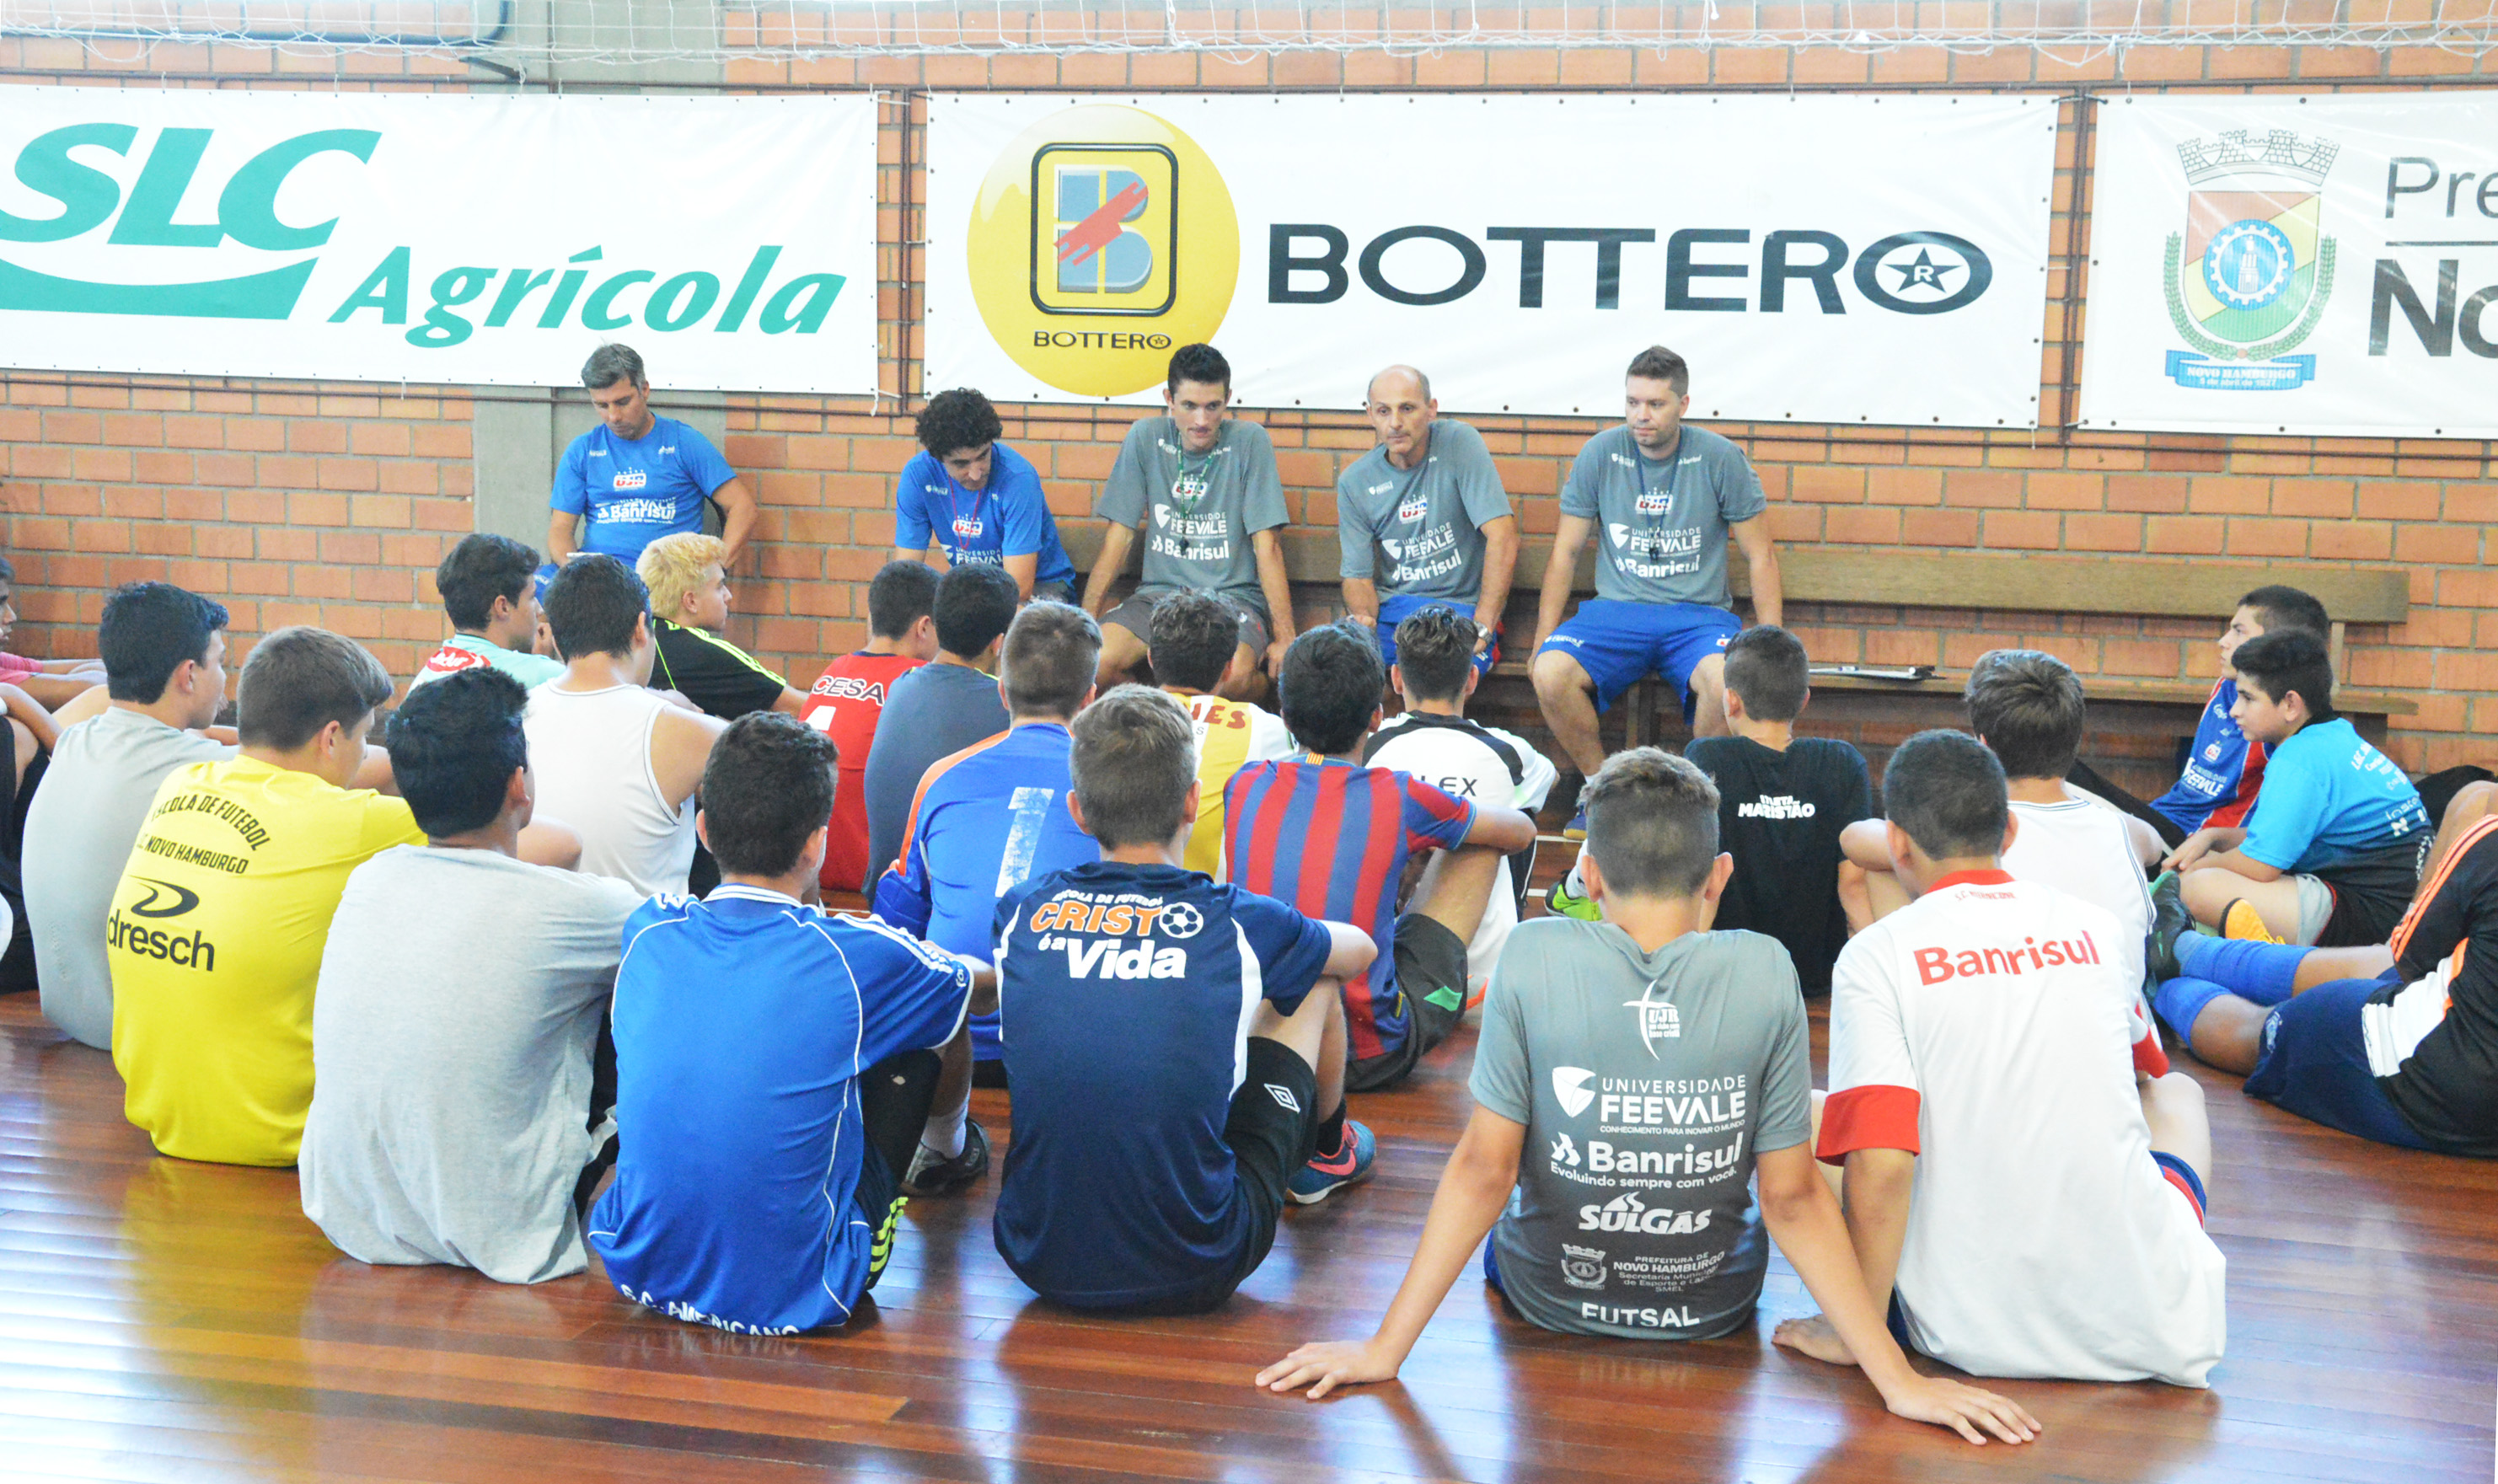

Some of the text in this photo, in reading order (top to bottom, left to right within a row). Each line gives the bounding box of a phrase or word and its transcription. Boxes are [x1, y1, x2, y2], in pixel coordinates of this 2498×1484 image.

[0, 122, 383, 251] SLC
[1268, 223, 1993, 314] BOTTERO
[327, 244, 846, 347] Agrícola
[1033, 331, 1172, 349] BOTTERO
[2187, 367, 2297, 379] NOVO HAMBURGO
[1624, 554, 1701, 579] Banrisul
[196, 796, 220, 813] DE
[214, 801, 271, 851] FUTEBOL
[145, 835, 177, 858] NOVO
[174, 844, 249, 875] HAMBURGO
[995, 786, 1054, 898] 1
[1095, 893, 1115, 904] DE
[108, 908, 215, 972] dresch
[1067, 938, 1187, 980] Vida
[1913, 930, 2101, 986] Banrisul
[1648, 1008, 1680, 1023] UJR
[1602, 1074, 1746, 1095] UNIVERSIDADE
[1600, 1090, 1746, 1125] FEEVALE
[1600, 1119, 1745, 1135] CONHECIMENTO PARA INOVAR O MUNDO
[1589, 1132, 1744, 1175] Banrisul
[1551, 1161, 1616, 1187] Evoluindo
[1620, 1178, 1672, 1190] sempre
[1676, 1177, 1704, 1189] com
[1613, 1251, 1725, 1273] NOVO HAMBURGO
[1635, 1251, 1709, 1264] PREFEITURA DE
[1619, 1272, 1670, 1280] Secretaria
[1581, 1301, 1701, 1328] FUTSAL
